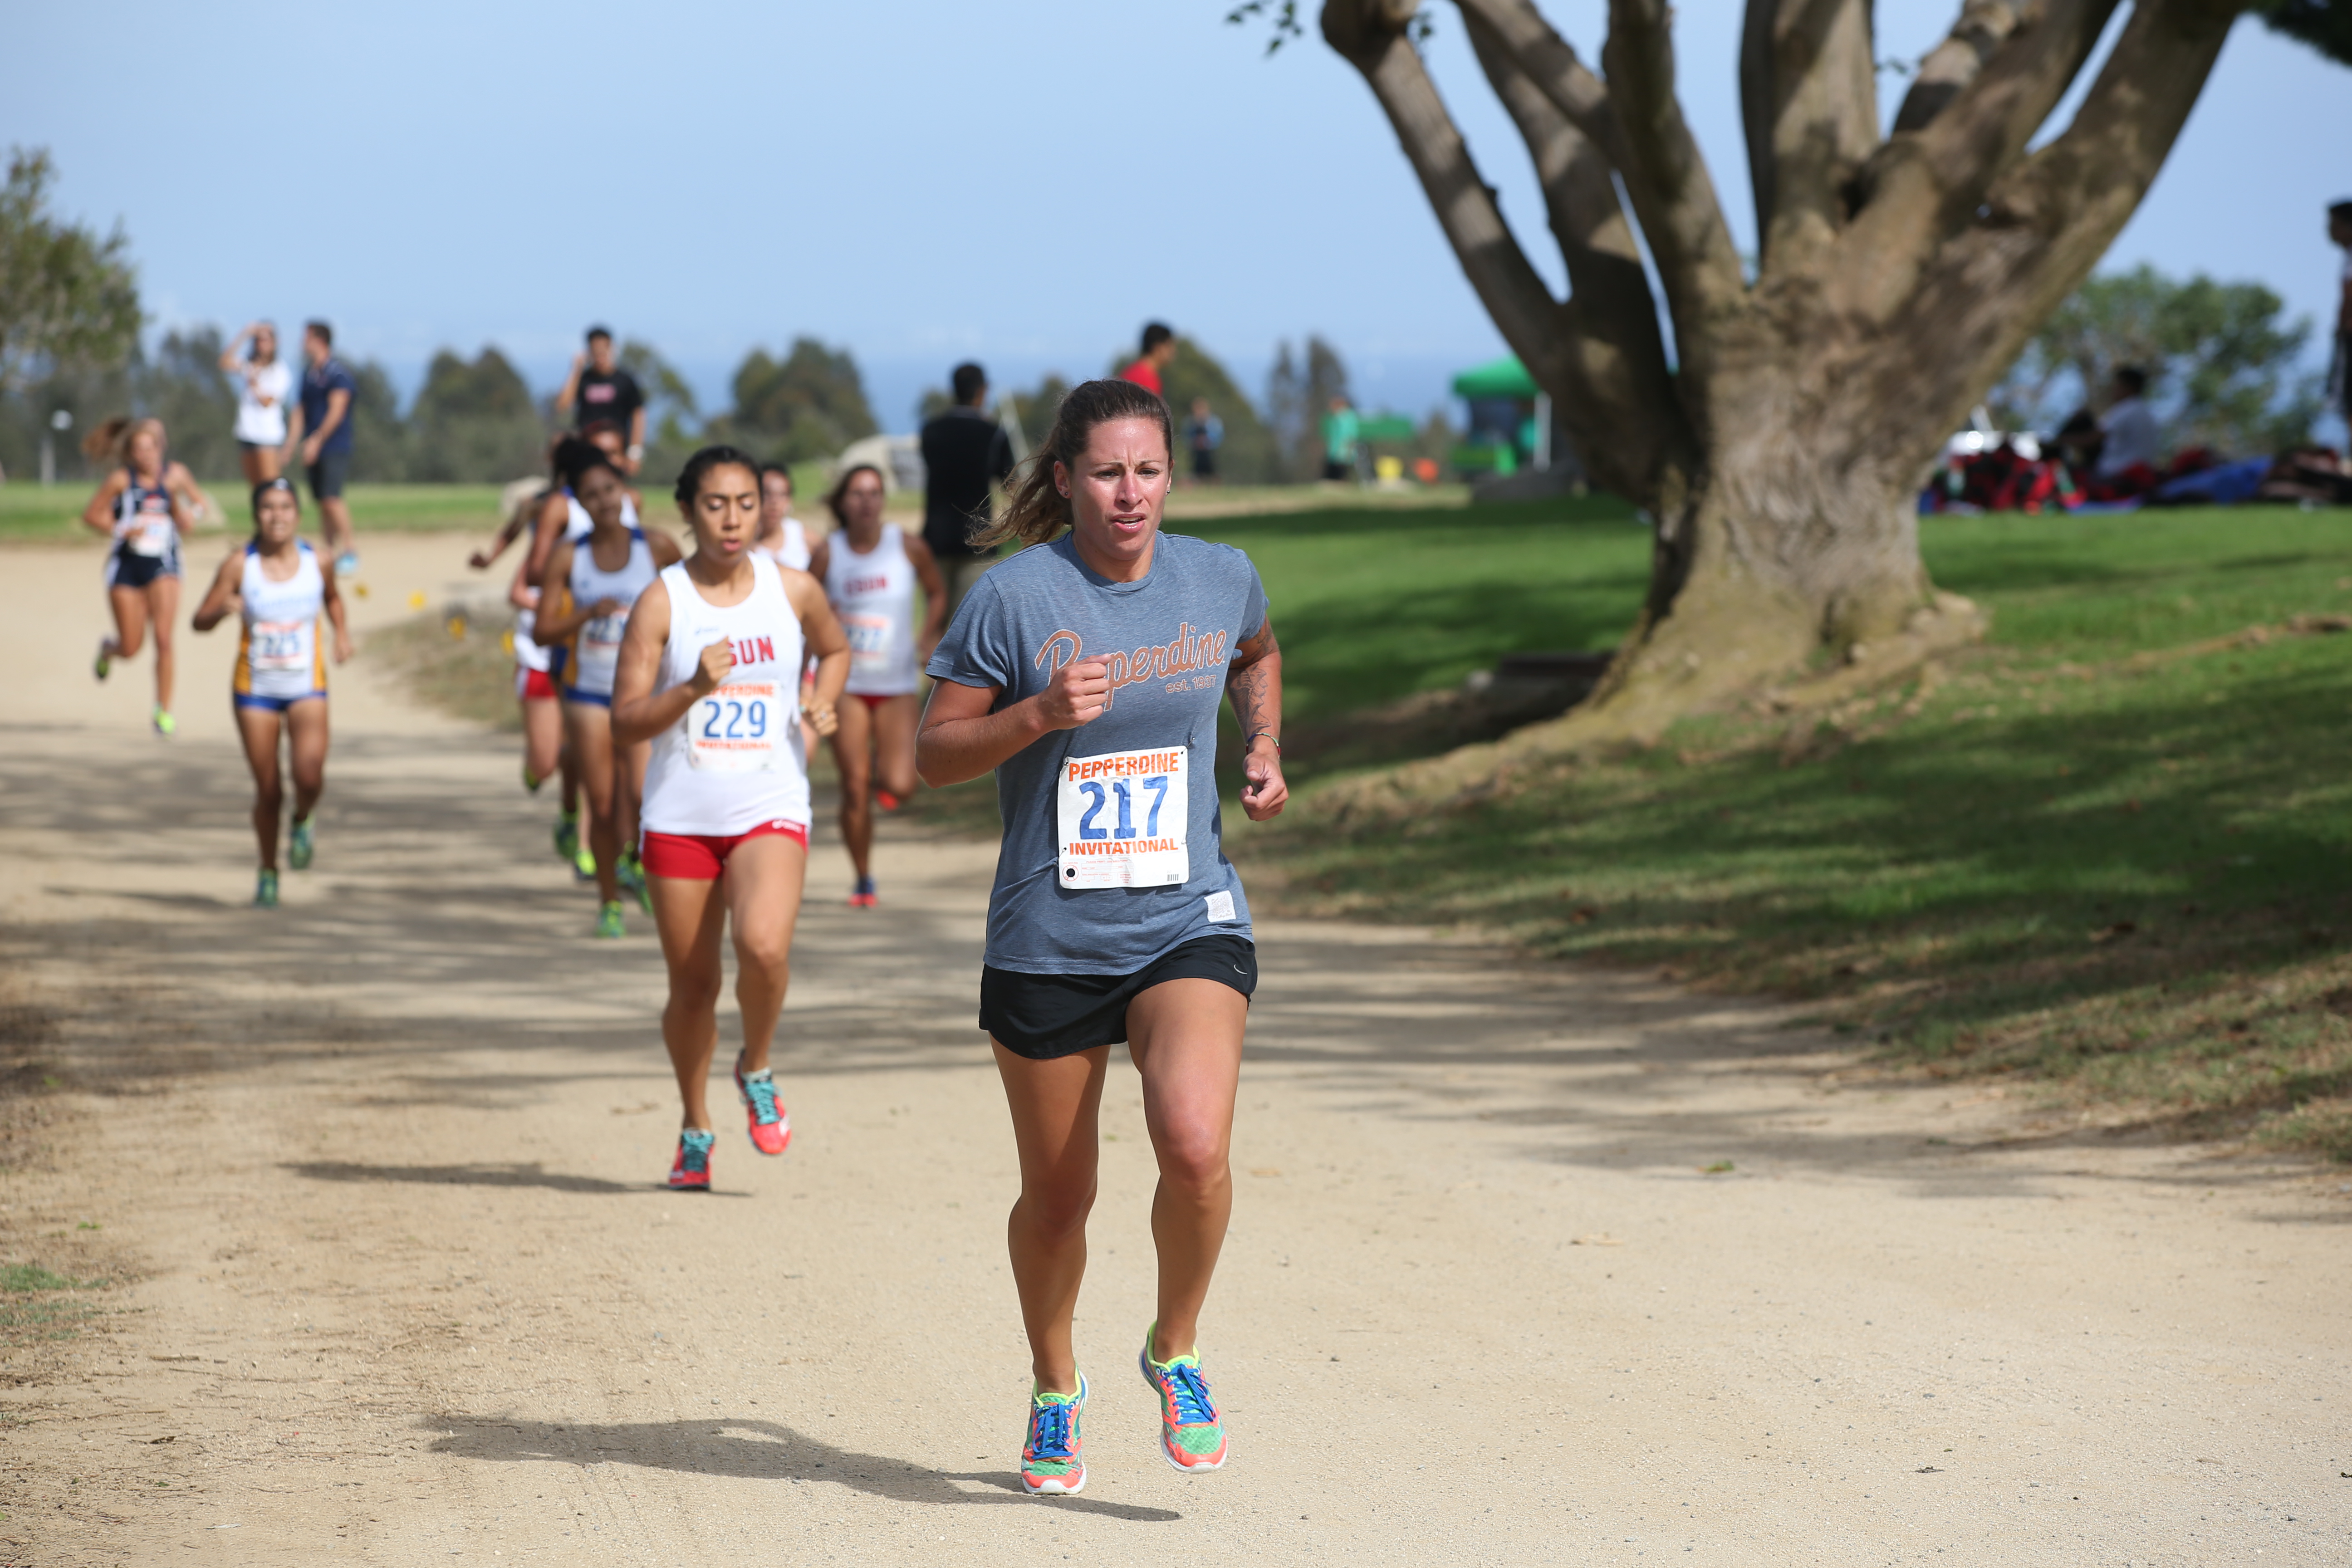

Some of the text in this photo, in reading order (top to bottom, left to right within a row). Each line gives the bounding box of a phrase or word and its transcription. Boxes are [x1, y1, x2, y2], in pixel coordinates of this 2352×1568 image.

[1034, 622, 1226, 712] Pperdine
[1166, 674, 1216, 693] est. 1937
[705, 701, 765, 737] 229
[1068, 752, 1179, 781] PEPPERDINE
[1079, 776, 1168, 840] 217
[1069, 838, 1179, 856] INVITATIONAL
